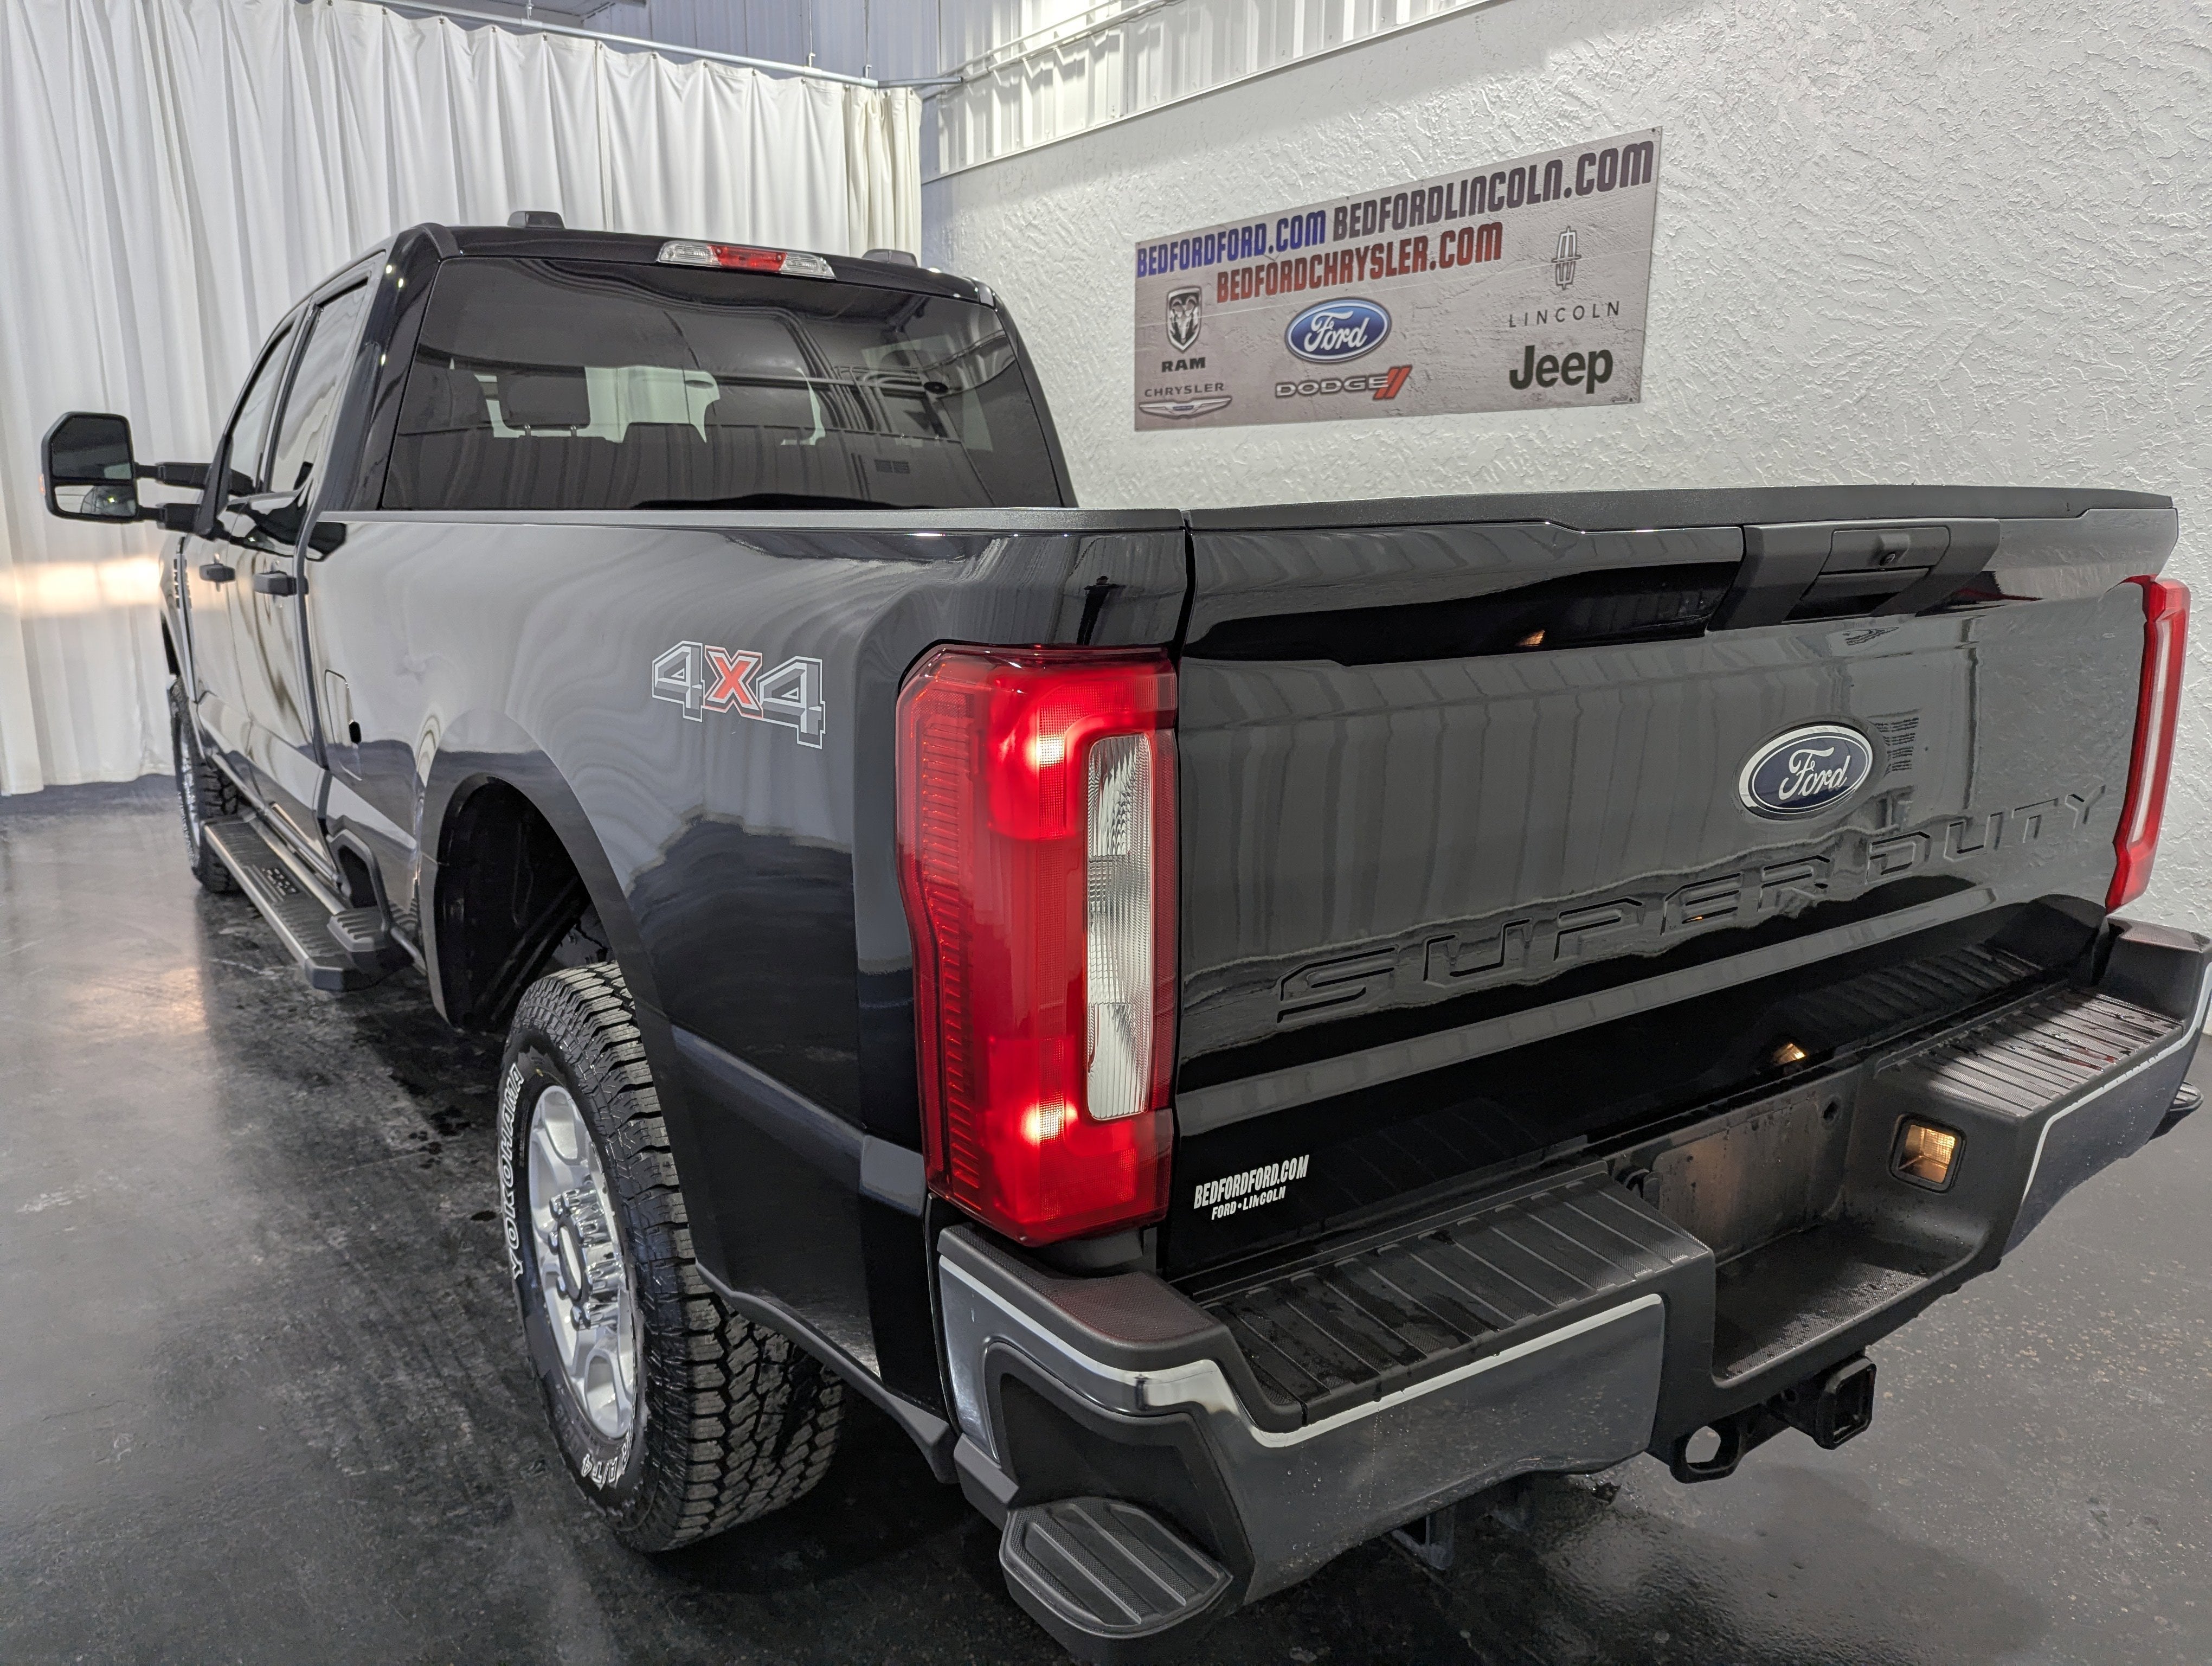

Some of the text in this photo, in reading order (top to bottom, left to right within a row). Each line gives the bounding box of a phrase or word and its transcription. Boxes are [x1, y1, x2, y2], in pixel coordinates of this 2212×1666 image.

[1137, 140, 1654, 278] BEDFORDFORD.COM BEDFORDLINCOLN.COM
[1217, 221, 1503, 304] BEDFORDCHRYSLER.COM
[1303, 311, 1370, 353] Ford
[1509, 300, 1619, 328] LINCOLN
[1144, 382, 1224, 397] CHRYSLER
[1161, 358, 1206, 373] RAM
[1275, 373, 1390, 398] DODGE
[1509, 345, 1613, 394] Jeep
[1778, 747, 1851, 800] Ford
[1276, 784, 2107, 1023] SUPER DUTY
[500, 1062, 525, 1280] YOKOHAMA
[1193, 1155, 1309, 1209] BEDFORDFORD.COM
